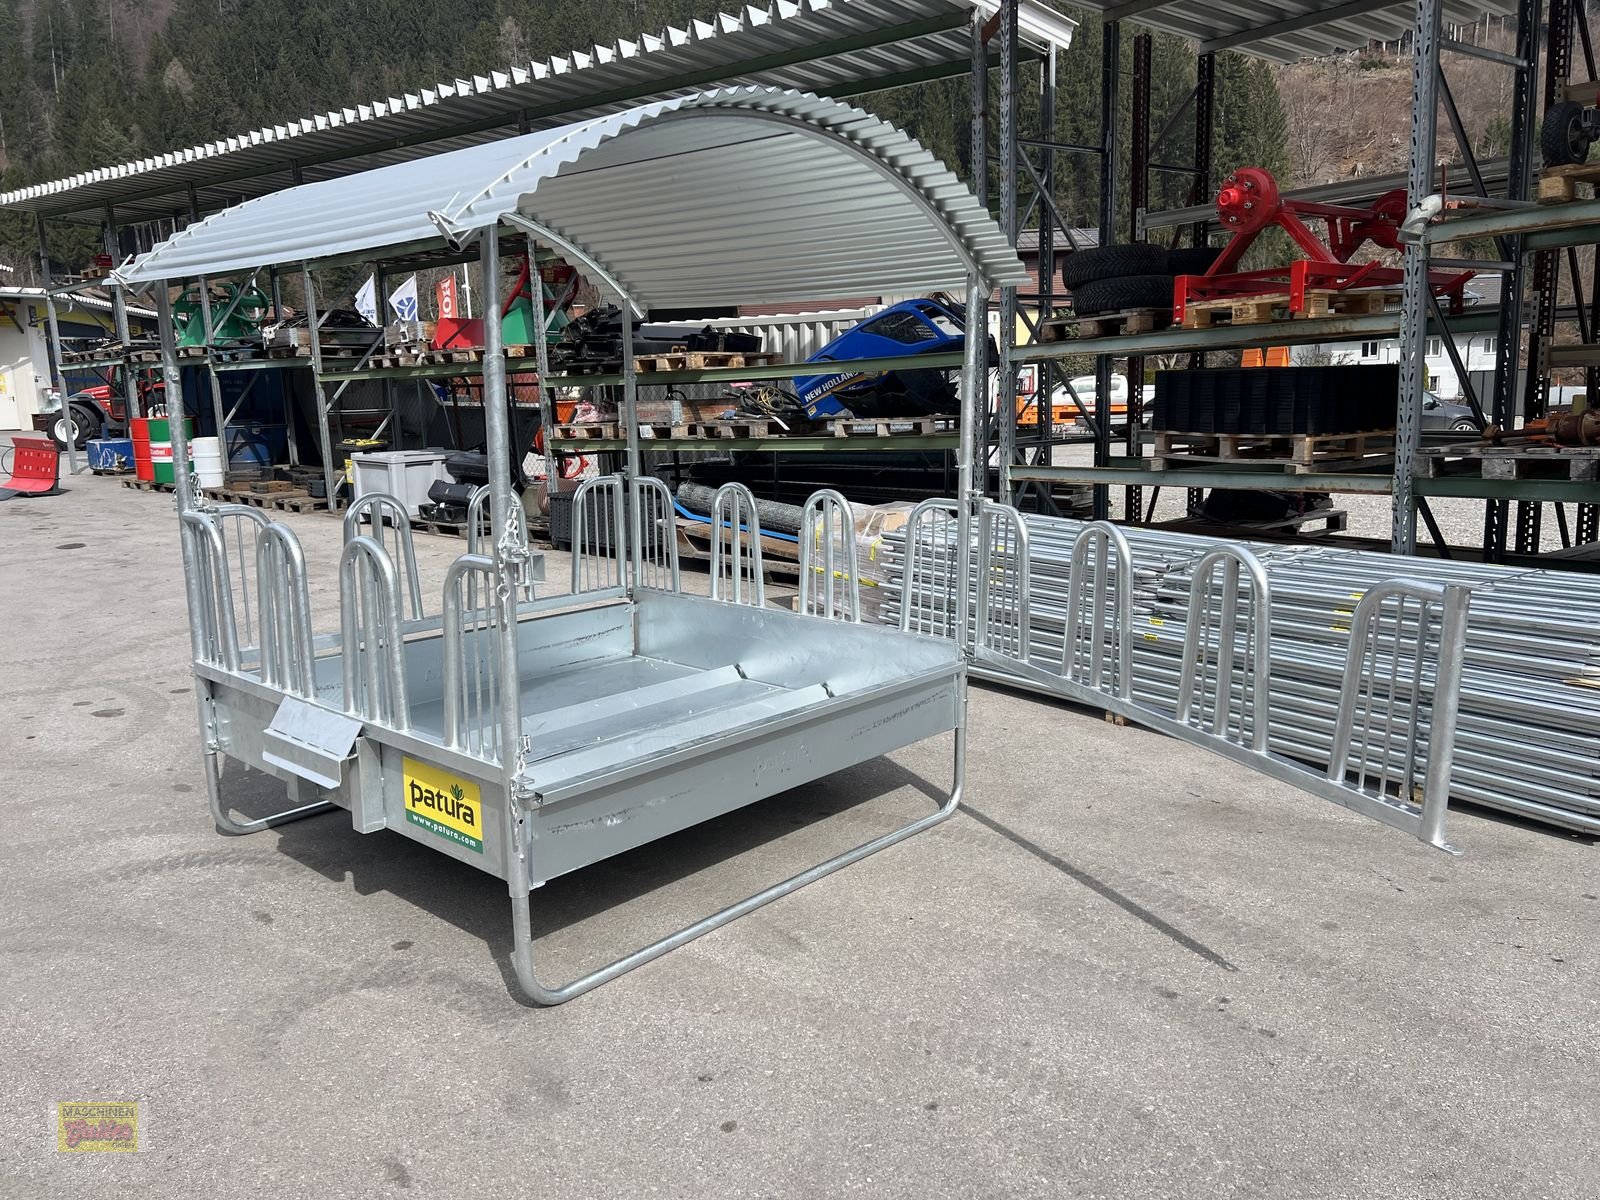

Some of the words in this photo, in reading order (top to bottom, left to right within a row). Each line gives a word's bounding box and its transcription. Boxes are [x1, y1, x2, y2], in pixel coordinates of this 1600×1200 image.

[804, 387, 823, 403] NEW
[409, 779, 475, 826] patura
[412, 814, 476, 847] www.patura.com
